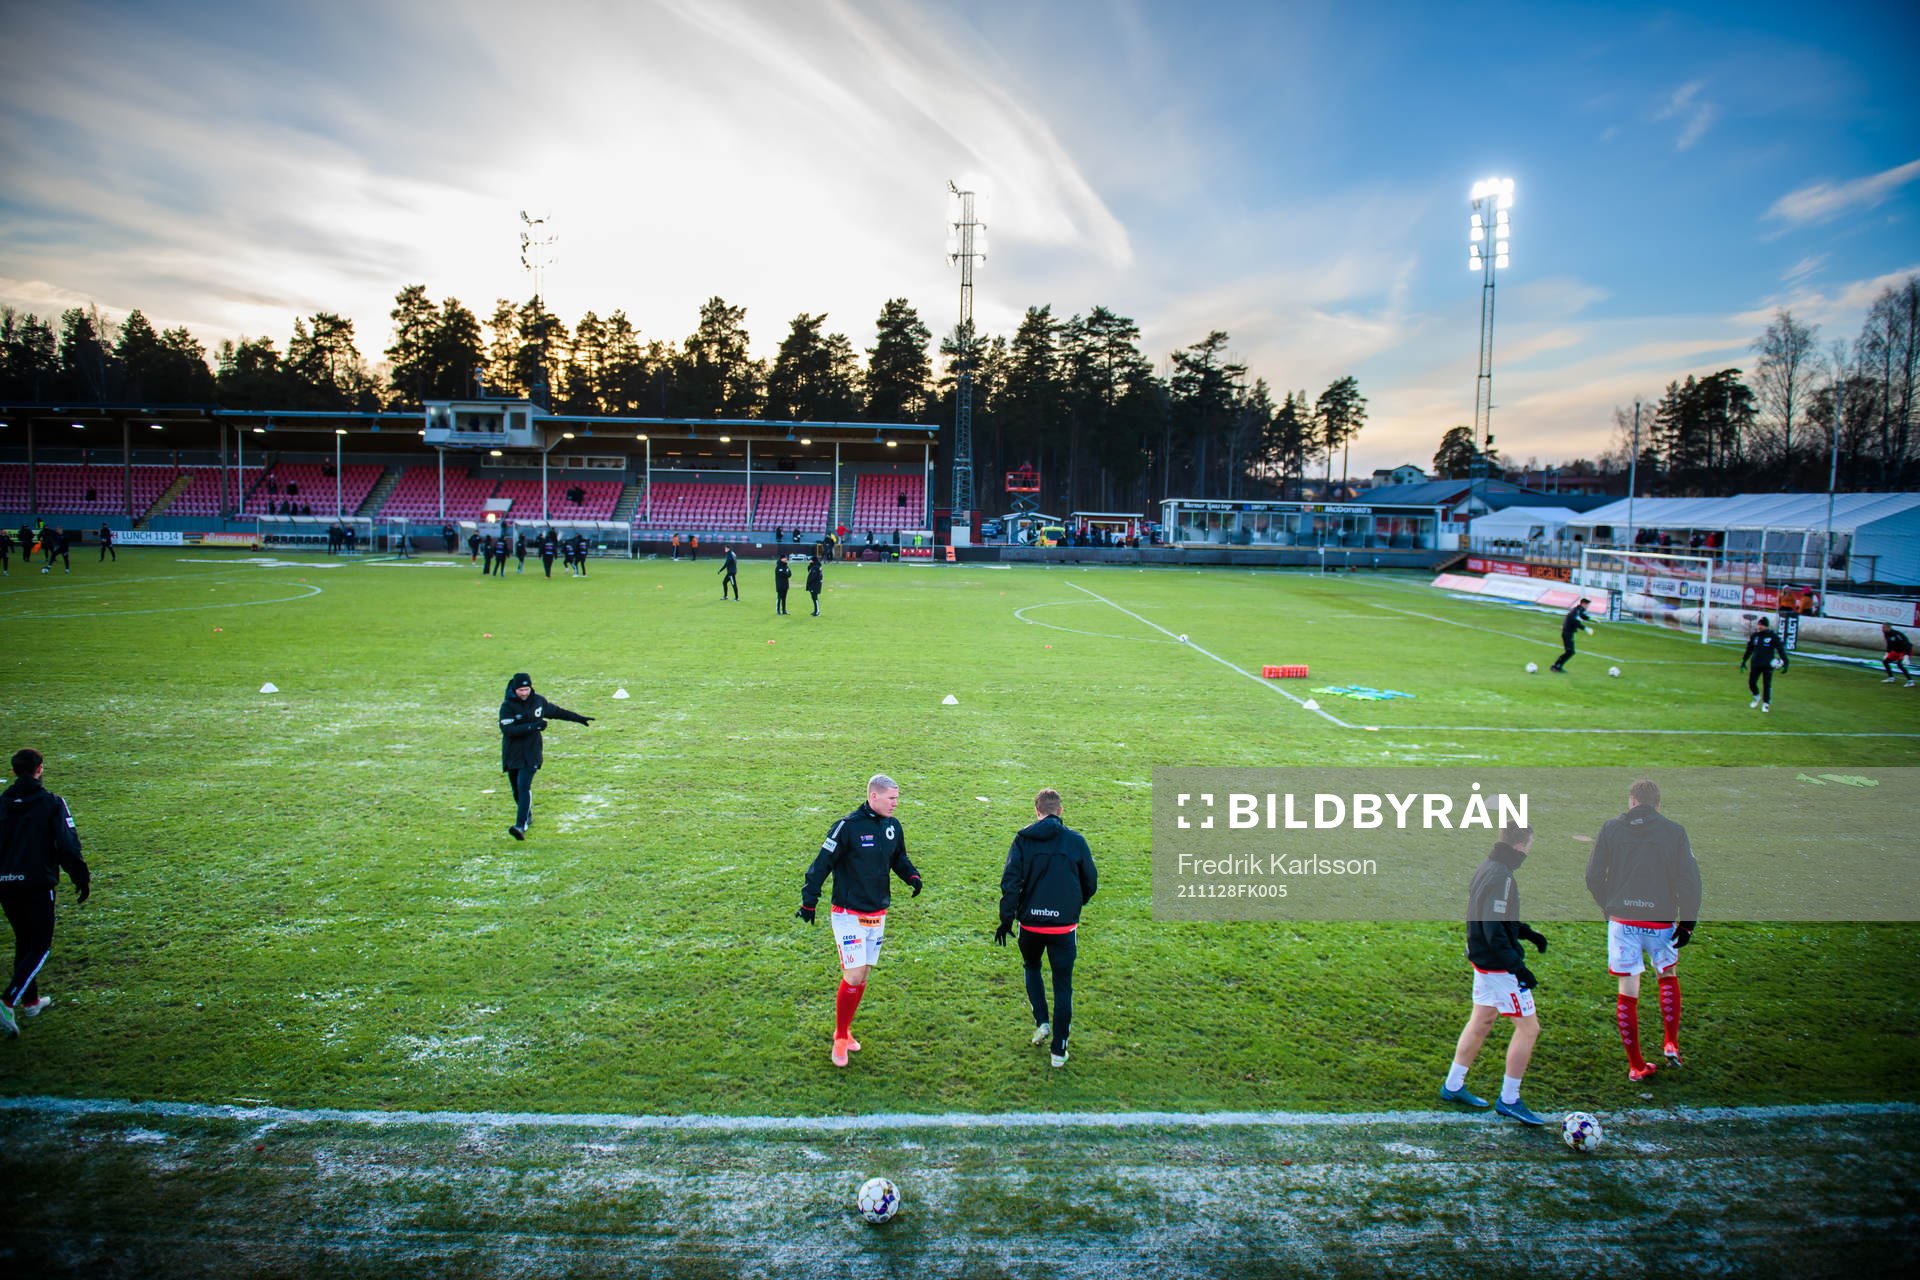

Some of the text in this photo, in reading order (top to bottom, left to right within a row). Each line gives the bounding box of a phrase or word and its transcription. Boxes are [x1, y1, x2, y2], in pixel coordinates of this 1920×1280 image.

[1325, 505, 1372, 514] McDonald's
[122, 532, 151, 540] LUNCH
[155, 532, 179, 541] 11-14
[1688, 584, 1741, 601] KROHALLEN
[1787, 617, 1797, 649] SELECT
[0, 873, 24, 881] mbro
[1624, 898, 1655, 908] umbro
[1031, 908, 1060, 917] umbro
